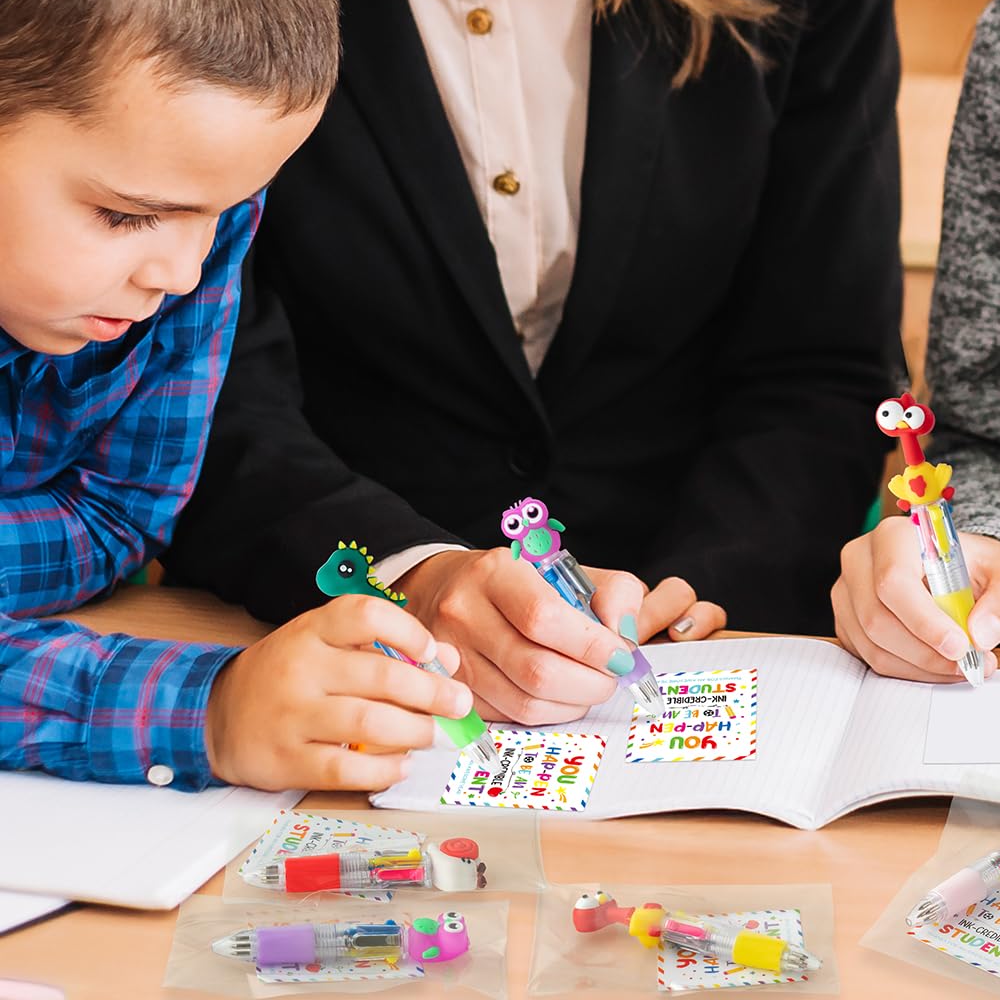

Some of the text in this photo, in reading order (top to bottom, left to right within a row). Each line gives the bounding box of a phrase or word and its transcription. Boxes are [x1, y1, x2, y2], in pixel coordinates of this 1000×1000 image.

[659, 682, 736, 695] STUDENT
[666, 695, 727, 705] INK-CREDIBLE
[662, 710, 680, 719] AN
[684, 709, 699, 719] BE
[650, 721, 731, 733] HAP-PEN
[669, 735, 717, 749] YOU
[518, 764, 533, 775] BE
[530, 746, 562, 797] HAP-PEN
[556, 755, 585, 784] YOU
[512, 776, 528, 789] AN
